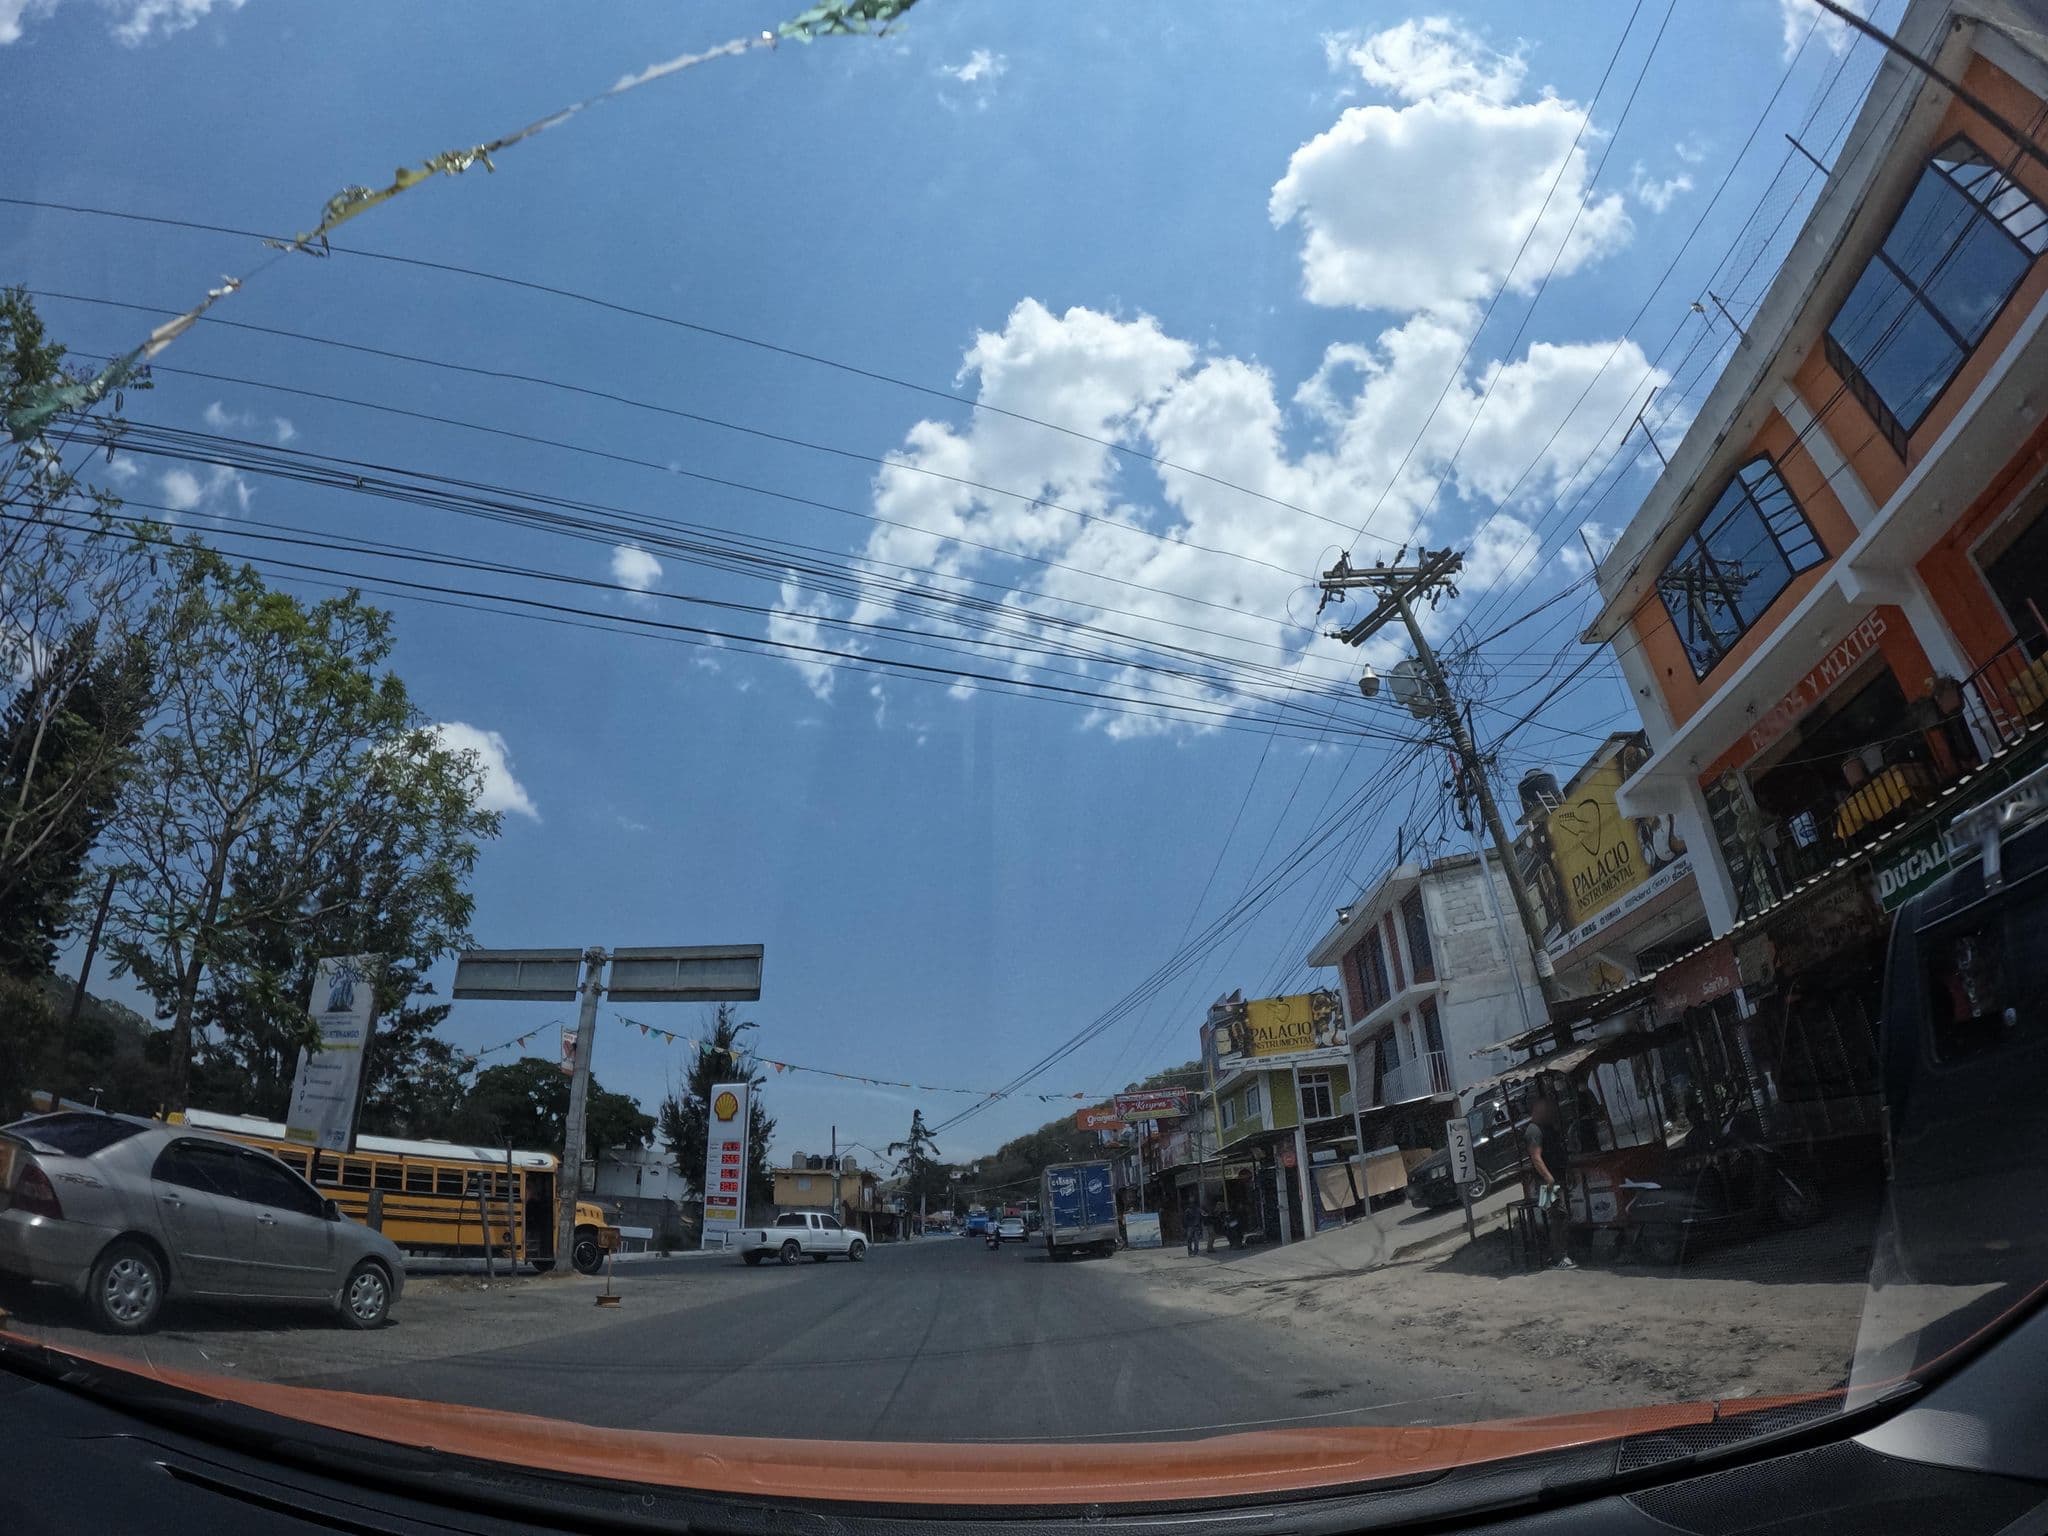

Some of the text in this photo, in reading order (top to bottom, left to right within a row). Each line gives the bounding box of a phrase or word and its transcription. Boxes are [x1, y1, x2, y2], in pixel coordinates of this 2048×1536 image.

[1805, 610, 1887, 696] Y MIXTAS
[1571, 841, 1630, 897] PALACIO
[1576, 866, 1636, 909] INSTRUMENTAL
[1880, 841, 1946, 897] DUCAL
[1250, 1021, 1312, 1042] PALACIO
